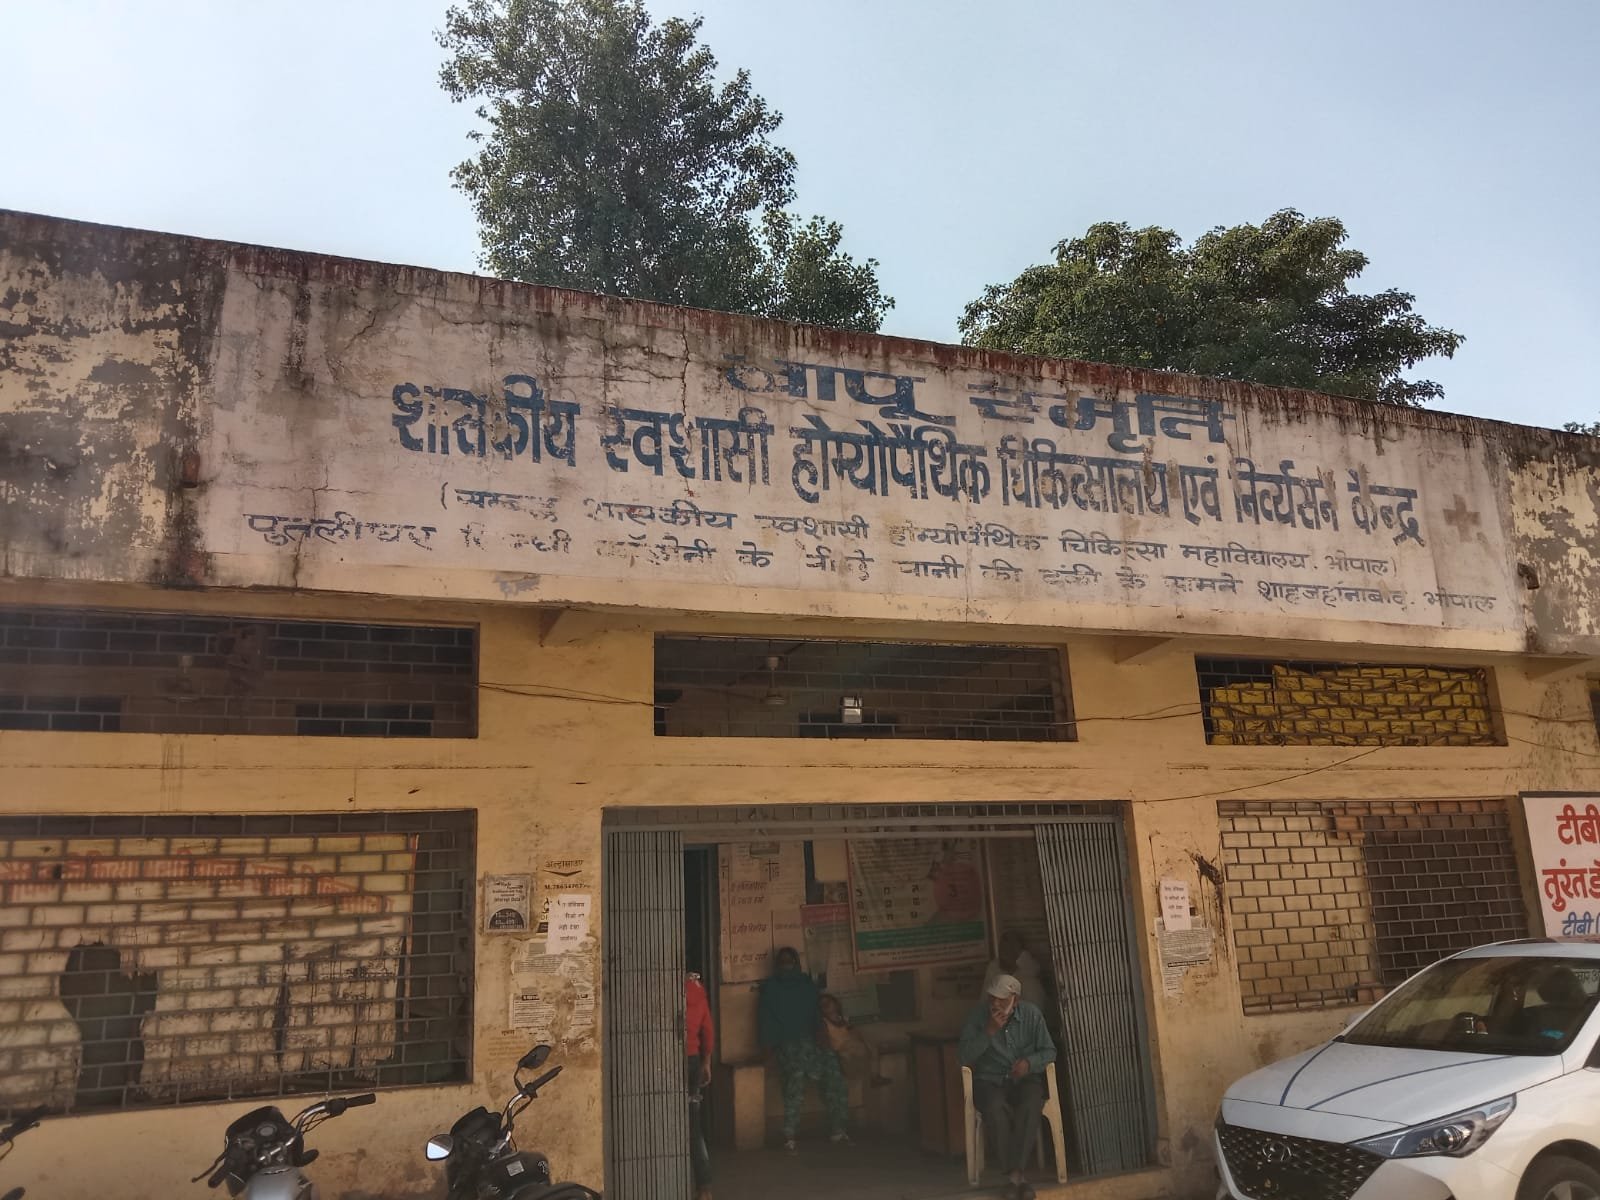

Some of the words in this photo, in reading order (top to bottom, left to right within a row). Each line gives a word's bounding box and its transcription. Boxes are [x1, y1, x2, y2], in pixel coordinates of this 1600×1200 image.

[723, 354, 957, 426] बापू
[392, 374, 581, 467] शासकीय
[600, 406, 775, 485] स्वशासी
[996, 434, 1170, 518] चिकित्सालय
[1180, 455, 1223, 527] एवं
[735, 541, 774, 569] के
[1423, 590, 1498, 613] भोपाल
[1059, 529, 1168, 562] चिकित्सा
[1542, 857, 1588, 912] तुरंत
[1562, 911, 1594, 936] टीबी
